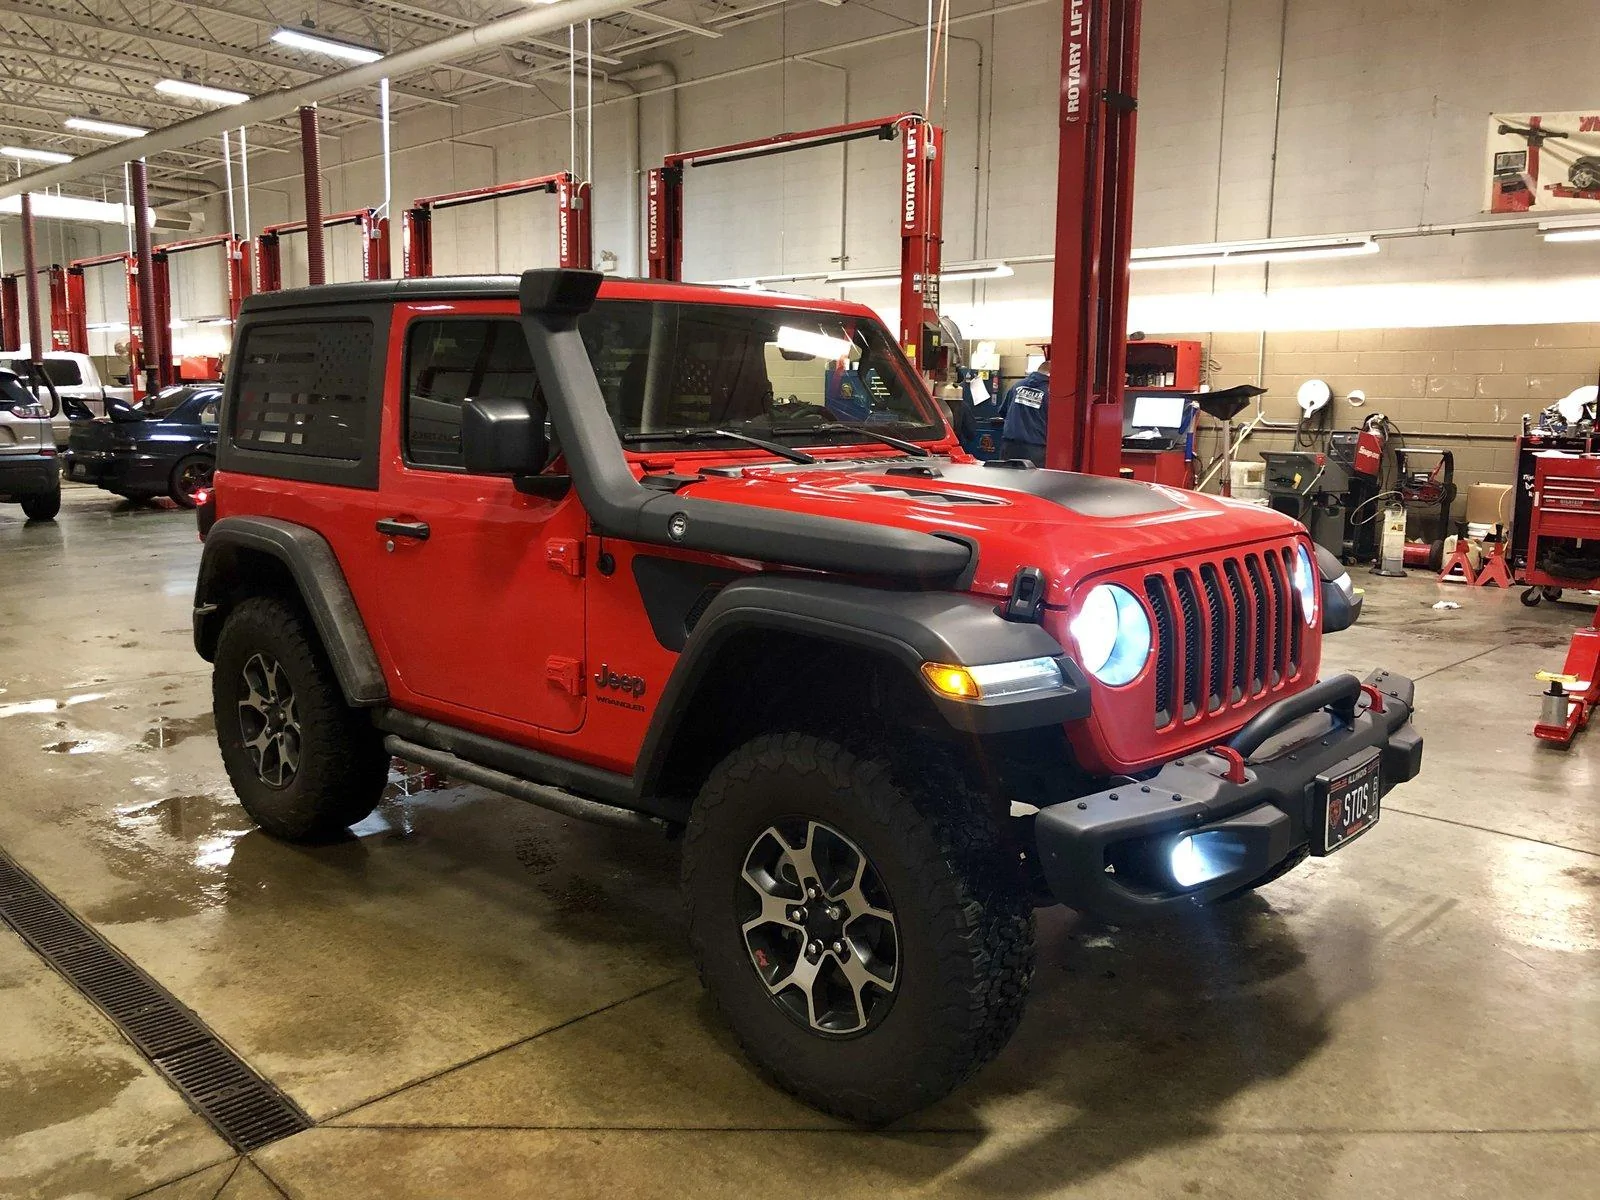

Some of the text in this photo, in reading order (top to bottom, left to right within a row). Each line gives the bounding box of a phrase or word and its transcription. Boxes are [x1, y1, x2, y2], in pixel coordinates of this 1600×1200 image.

[1067, 0, 1084, 113] ROTARY LIFT
[905, 128, 917, 222] ROTARY LIFT
[560, 211, 568, 256] ROTARY
[650, 170, 658, 248] ROTARY LIFT
[594, 663, 646, 698] Jeep
[596, 695, 646, 712] WRANGLER
